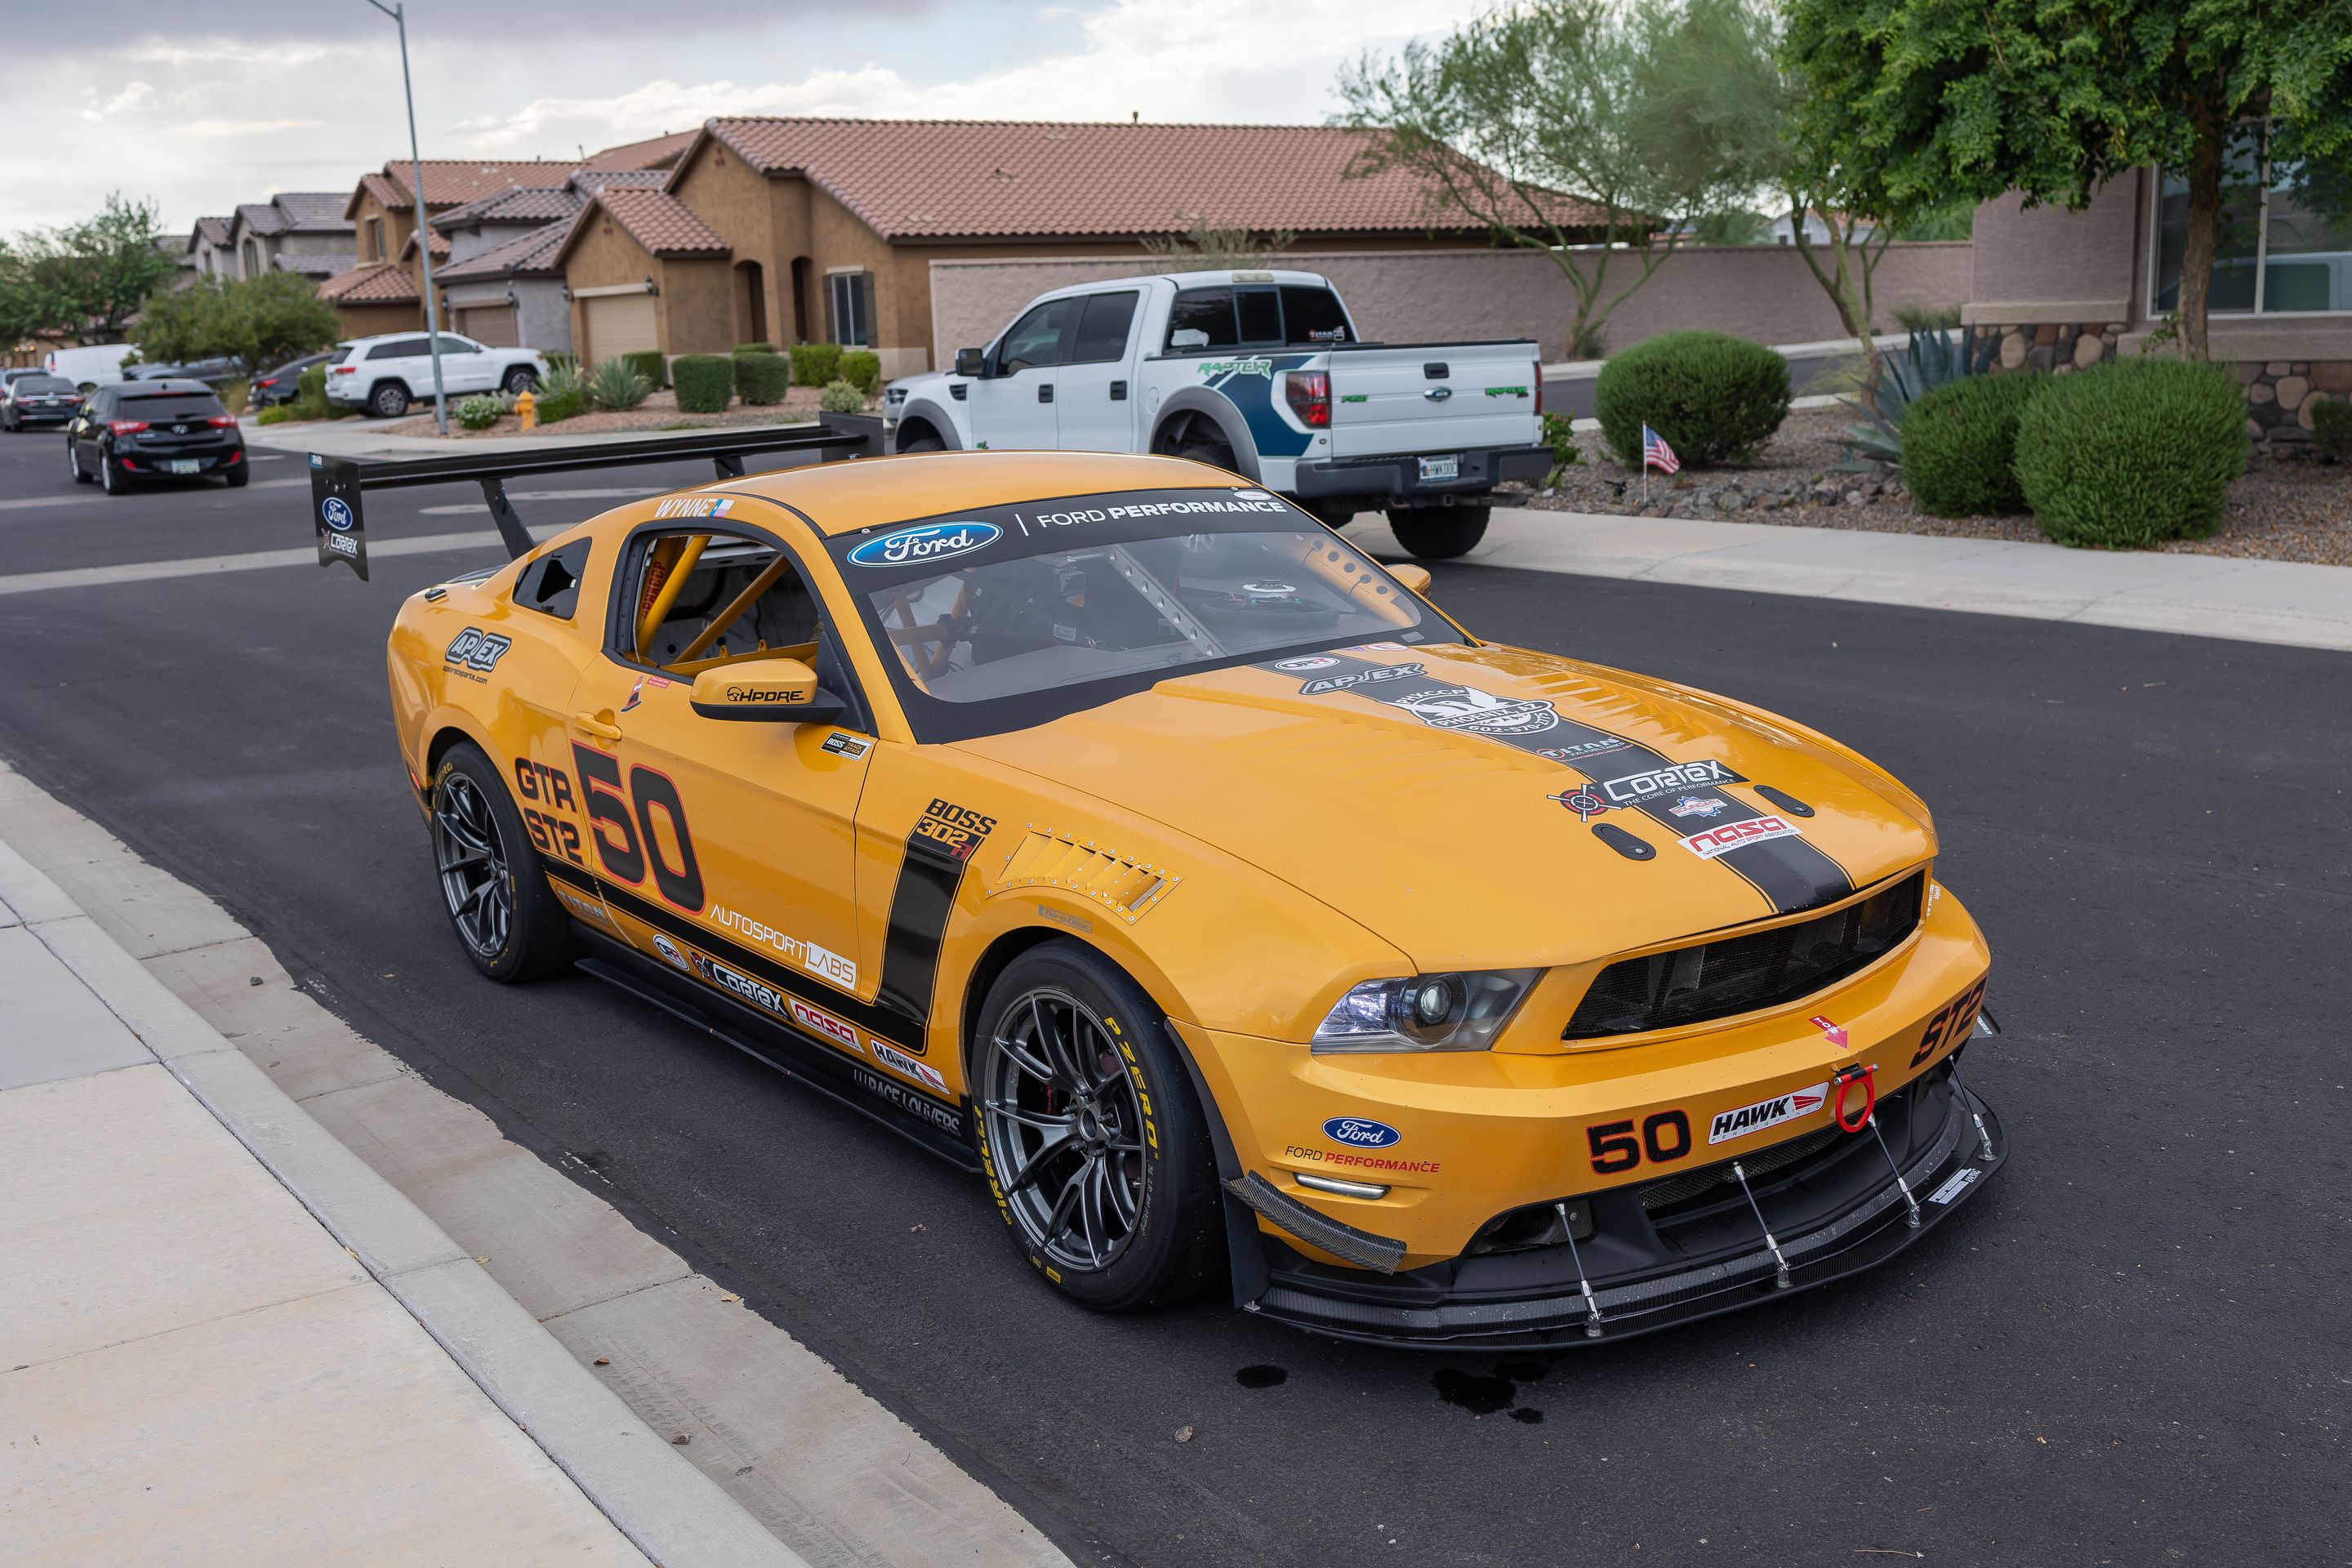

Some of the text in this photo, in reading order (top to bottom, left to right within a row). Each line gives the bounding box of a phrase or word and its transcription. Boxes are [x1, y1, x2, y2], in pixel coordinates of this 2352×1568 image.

[1197, 359, 1272, 379] RAPTOR
[327, 501, 347, 525] Ford
[654, 498, 718, 518] WYNNE
[1036, 501, 1287, 528] FORD PERFORMANCE
[884, 529, 973, 562] Ford
[739, 688, 804, 703] HPDRE
[1395, 689, 1466, 705] PHXCCP
[1521, 702, 1544, 712] AZ
[826, 737, 845, 748] BOSS
[1541, 737, 1621, 757] TITAN
[514, 756, 578, 814] GTR
[1623, 797, 1642, 806] THE
[1642, 791, 1664, 801] CORE
[1678, 778, 1736, 792] PERFORMANCE
[924, 797, 998, 835] BOSS
[1673, 800, 1721, 814] BOUNDARY
[523, 807, 585, 866] ST2
[570, 738, 706, 916] 50
[1703, 828, 1797, 857] NATIONAL AUTO SPORT ASSOCIATION
[1813, 1017, 1841, 1035] TOW
[1908, 974, 1988, 1071] ST2
[873, 1041, 919, 1077] HAWK
[1104, 1018, 1121, 1036] P
[1119, 1041, 1158, 1149] ZERO
[868, 1076, 961, 1134] RACE LOUVERS
[1713, 1096, 1792, 1137] HAWK
[1337, 1120, 1385, 1144] Ford
[1711, 1104, 1821, 1143] PERFORMANCE
[1585, 1108, 1692, 1176] 50
[1285, 1146, 1441, 1173] FORD PERFORMANCE
